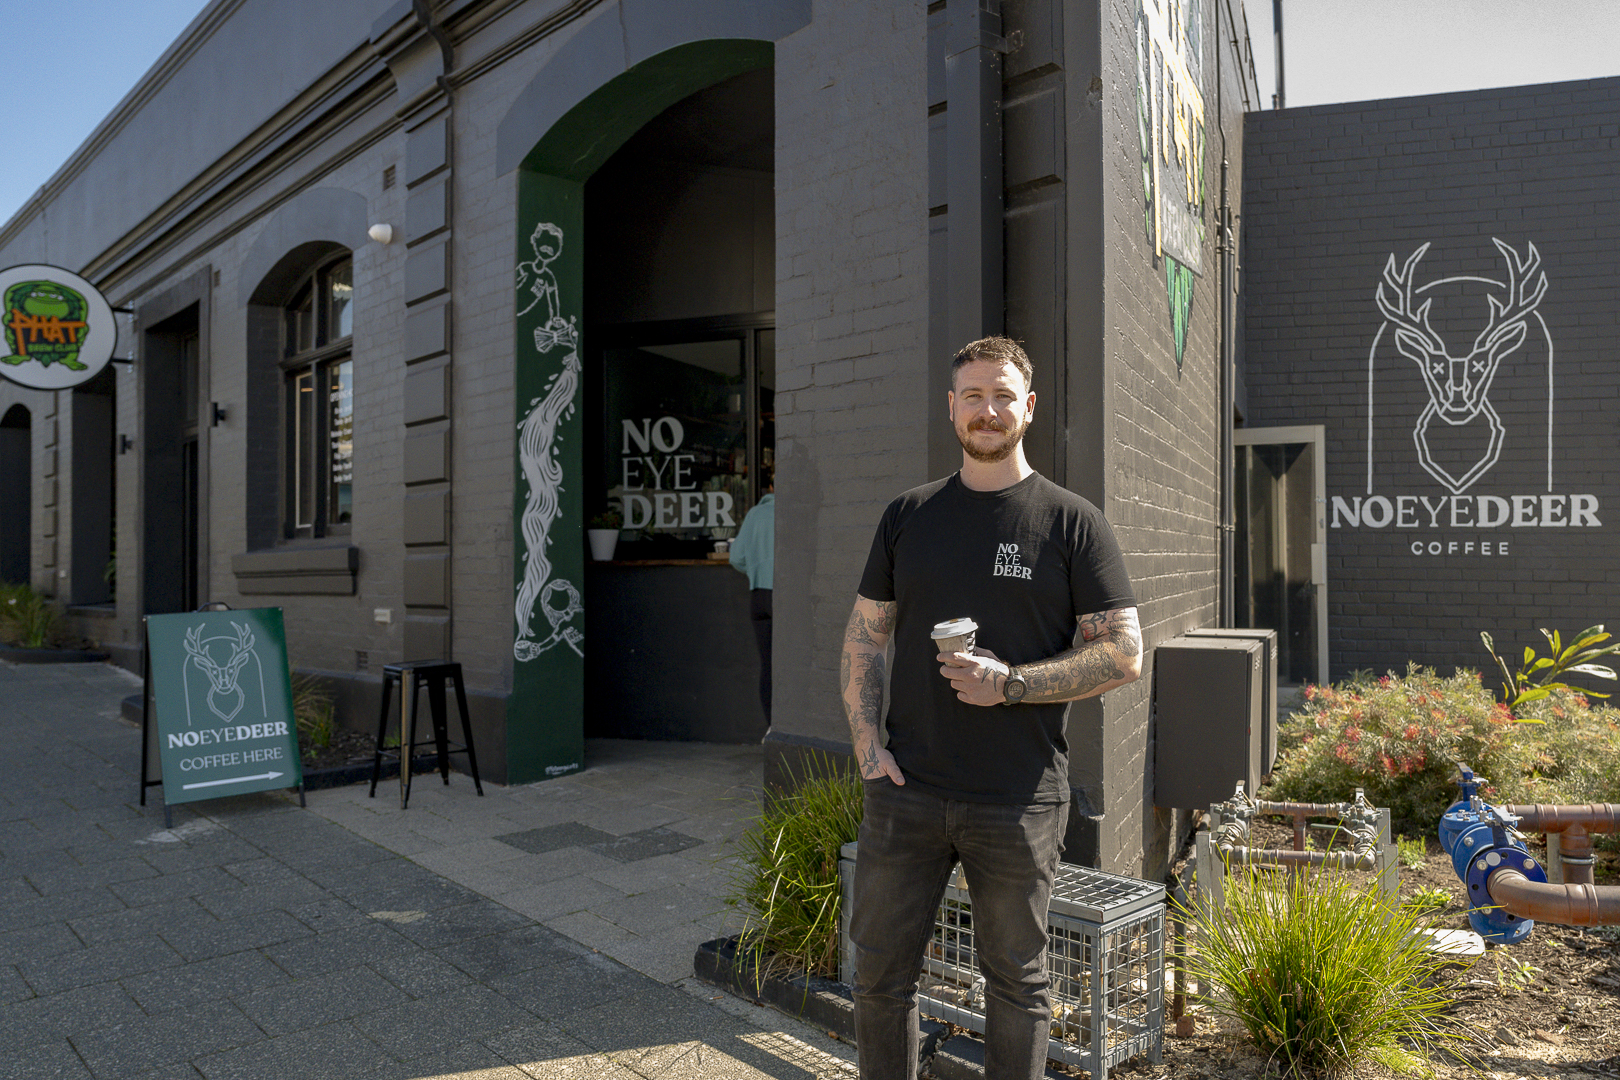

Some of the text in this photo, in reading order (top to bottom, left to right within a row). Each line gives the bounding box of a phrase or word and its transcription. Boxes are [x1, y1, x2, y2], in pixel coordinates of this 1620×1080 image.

[621, 416, 684, 454] NO
[622, 454, 697, 491] EYE
[622, 491, 736, 529] DEER
[997, 543, 1019, 554] NO
[1410, 541, 1509, 555] COFFEE
[994, 553, 1021, 566] EYE
[992, 564, 1032, 580] DEER
[179, 747, 284, 772] COFFEE HERE
